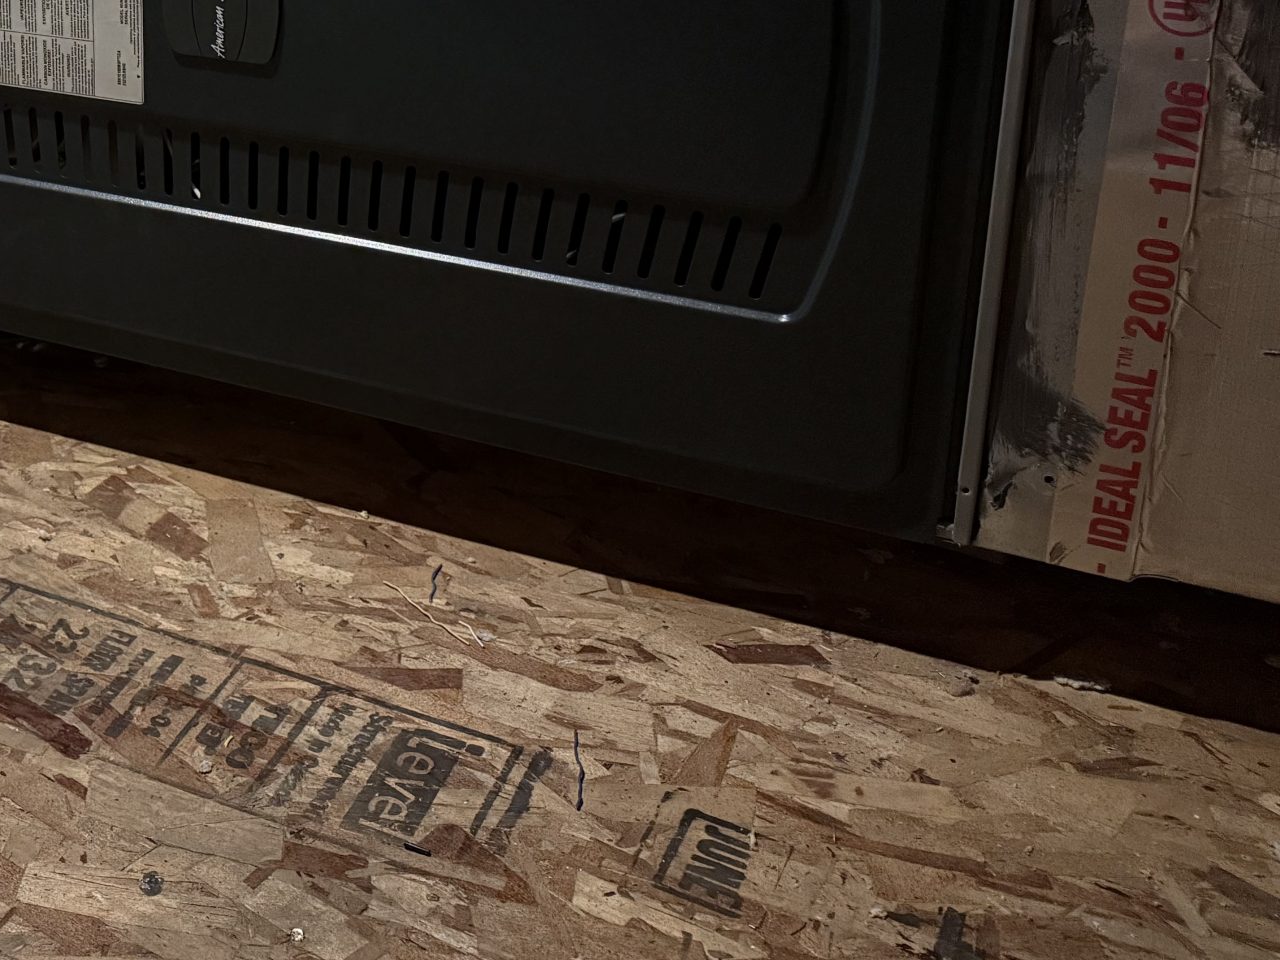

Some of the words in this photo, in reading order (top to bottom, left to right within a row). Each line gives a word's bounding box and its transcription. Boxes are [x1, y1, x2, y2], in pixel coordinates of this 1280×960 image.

[211, 6, 226, 58] American
[1149, 81, 1209, 195] 11/06
[1124, 238, 1181, 344] 2000
[1087, 461, 1142, 552] IDEAL
[678, 824, 752, 912] JUNE
